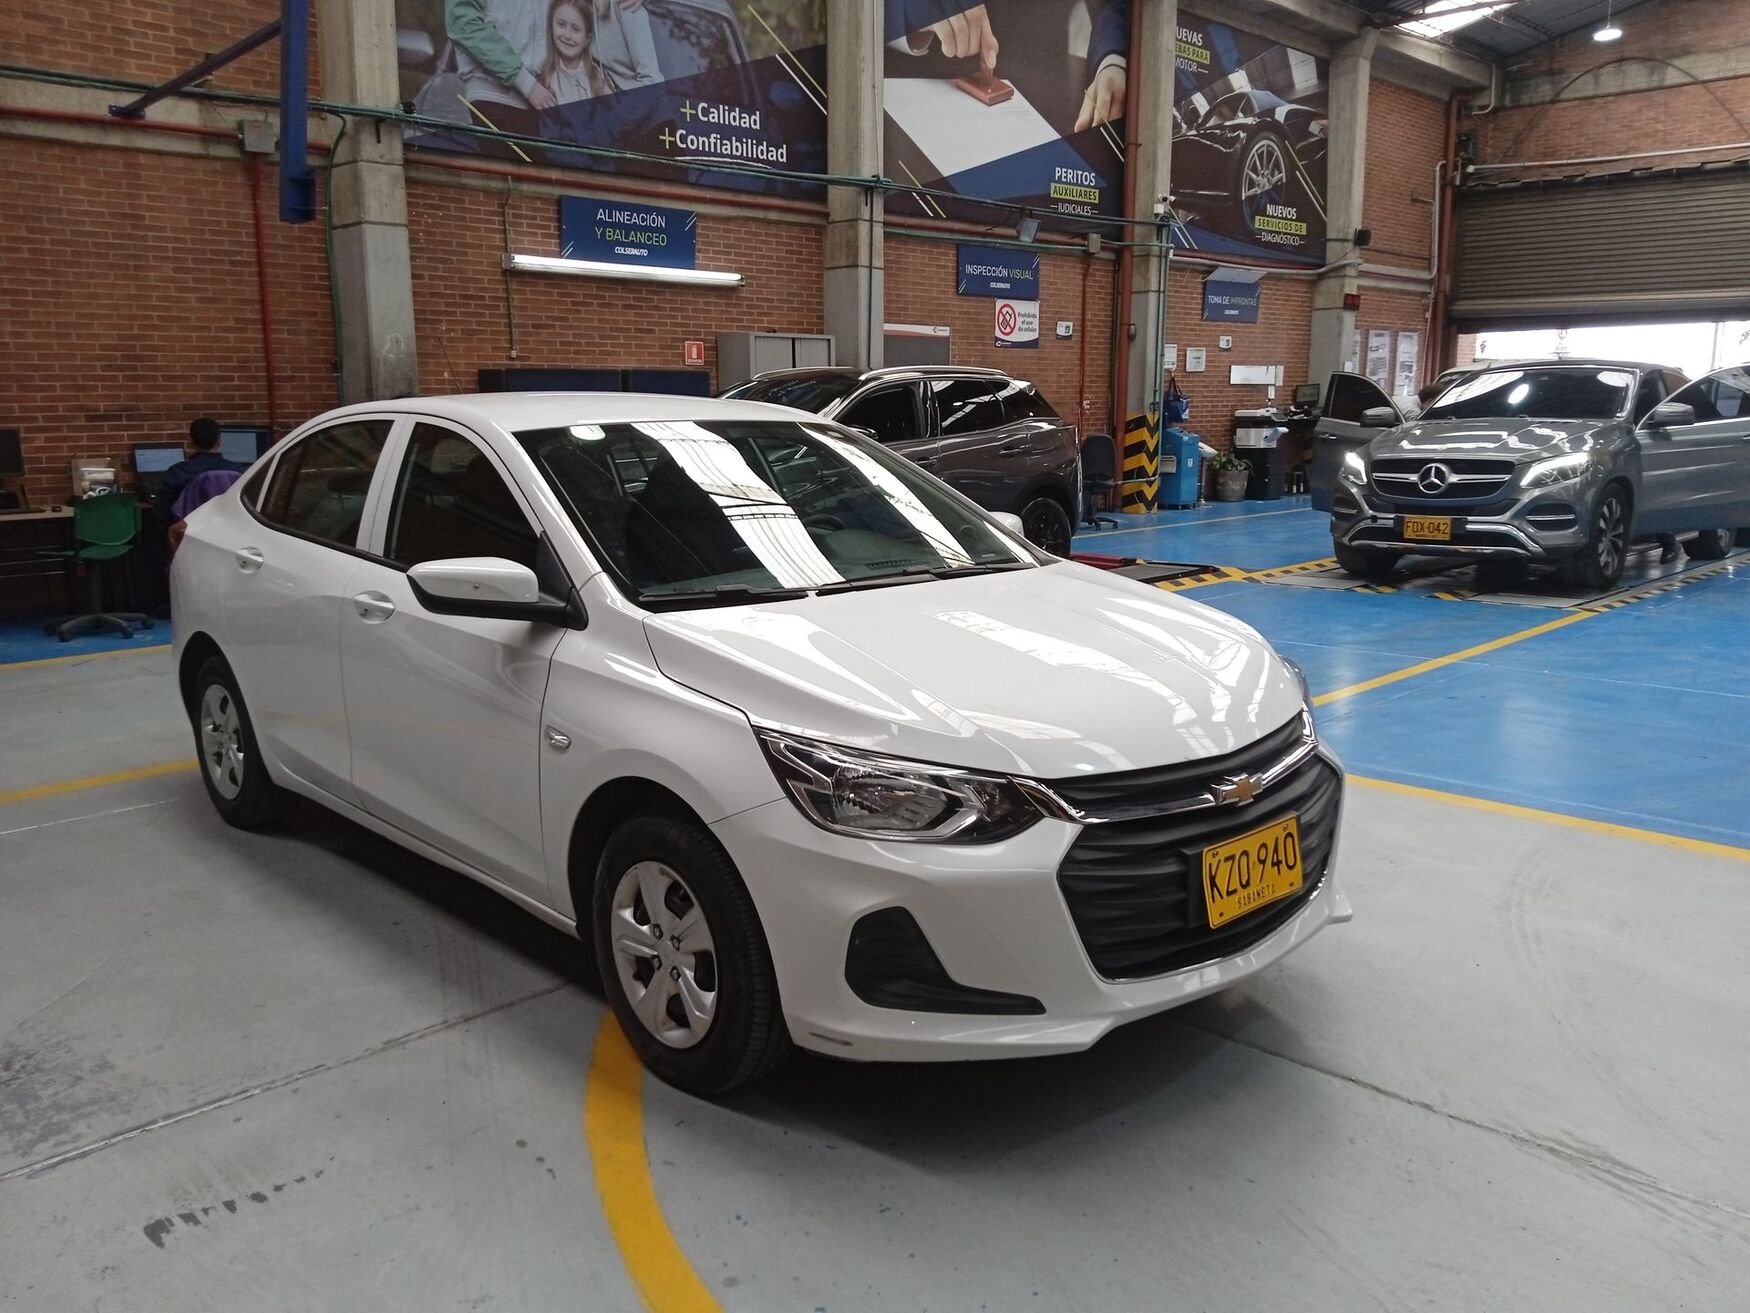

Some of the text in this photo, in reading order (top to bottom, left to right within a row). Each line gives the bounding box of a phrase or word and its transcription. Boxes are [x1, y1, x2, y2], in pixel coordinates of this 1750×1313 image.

[1176, 26, 1203, 46] UEVAS
[1175, 43, 1209, 62] EBAS PARA
[1055, 167, 1096, 186] PERITOS
[1052, 184, 1098, 201] AUXILIARES
[597, 208, 666, 228] ALINEACIÓN
[1058, 203, 1092, 216] JUDICIALES
[1267, 203, 1297, 219] NUEVOS
[1258, 218, 1304, 233] SERVICIOS DE
[595, 227, 667, 246] Y BALANCEO
[965, 263, 1034, 281] INSPECCIÓN VISUAL
[1208, 294, 1222, 304] TOMA
[1222, 296, 1230, 305] DE
[1257, 831, 1297, 883] 940
